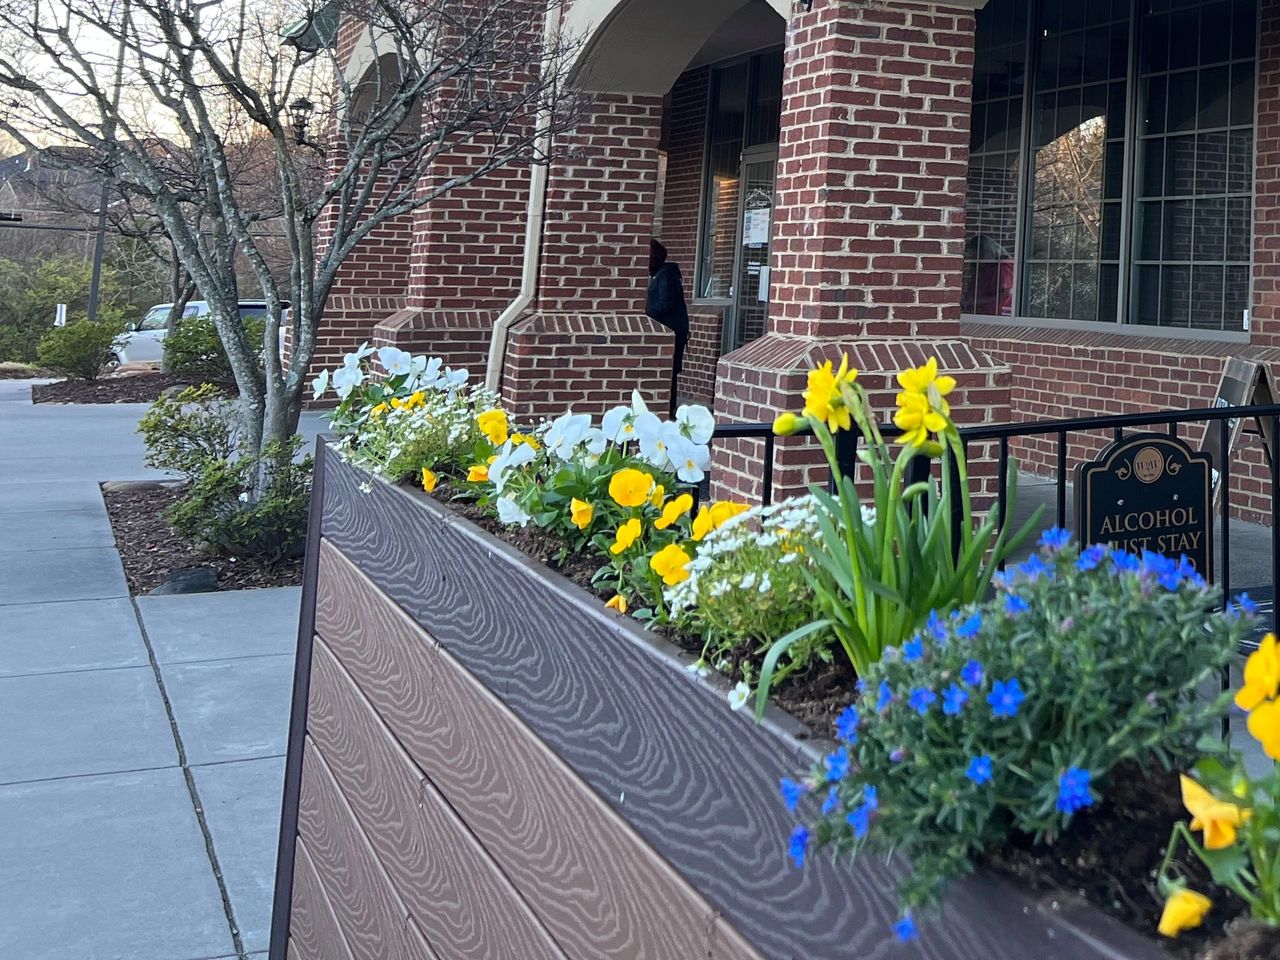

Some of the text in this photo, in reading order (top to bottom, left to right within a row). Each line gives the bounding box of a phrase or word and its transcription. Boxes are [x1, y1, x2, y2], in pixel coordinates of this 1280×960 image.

[1099, 506, 1198, 535] ALCOHOL
[1109, 531, 1202, 557] UST STAY
